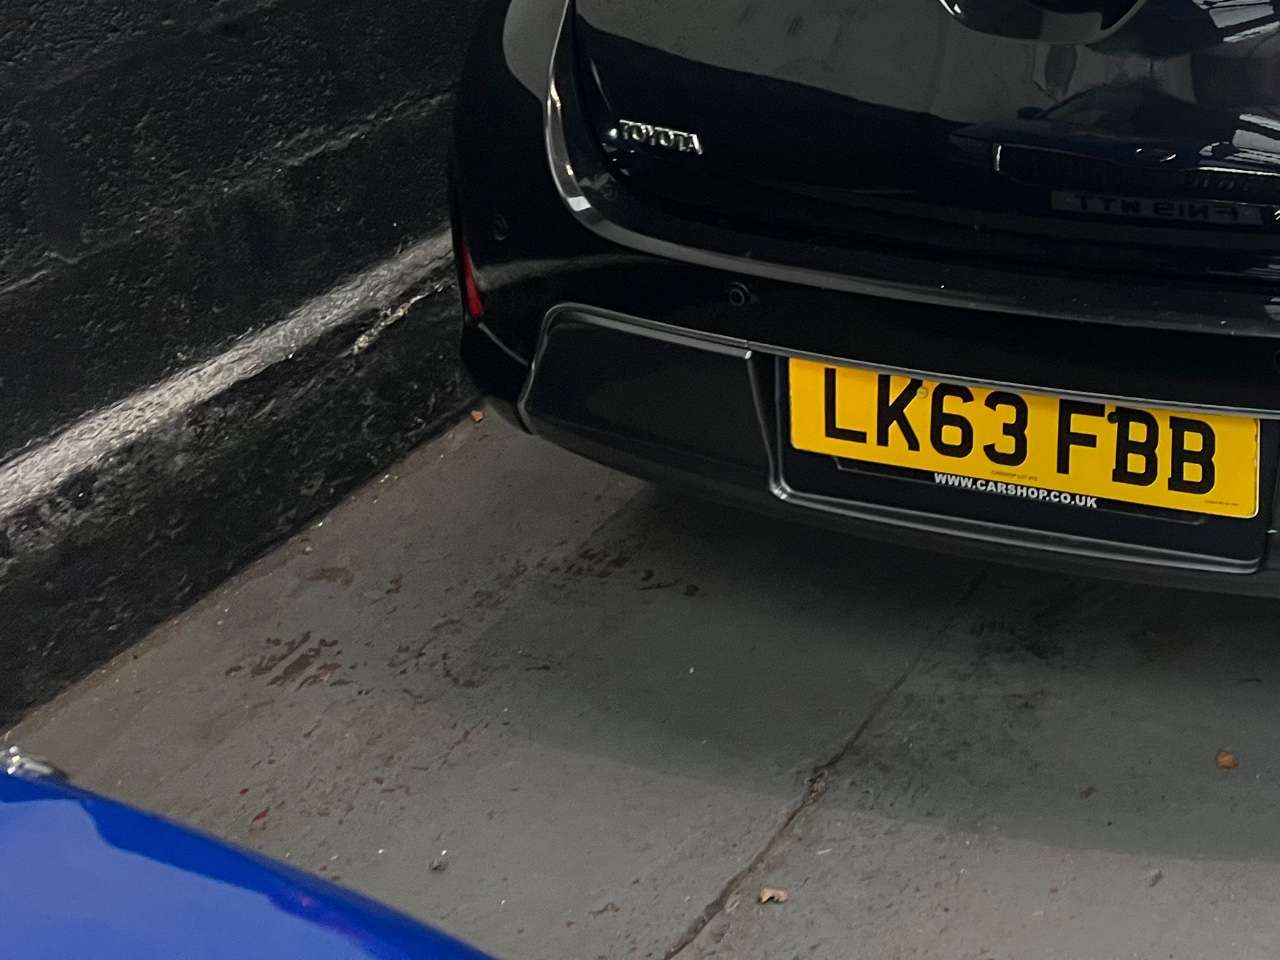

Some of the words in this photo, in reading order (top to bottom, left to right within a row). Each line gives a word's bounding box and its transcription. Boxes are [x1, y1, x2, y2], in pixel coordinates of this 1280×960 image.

[618, 119, 703, 155] TOYOTA
[823, 367, 1029, 468] LK63
[1054, 397, 1217, 496] FBB
[933, 472, 1098, 510] WWW.CARSHOP.CO.UK
